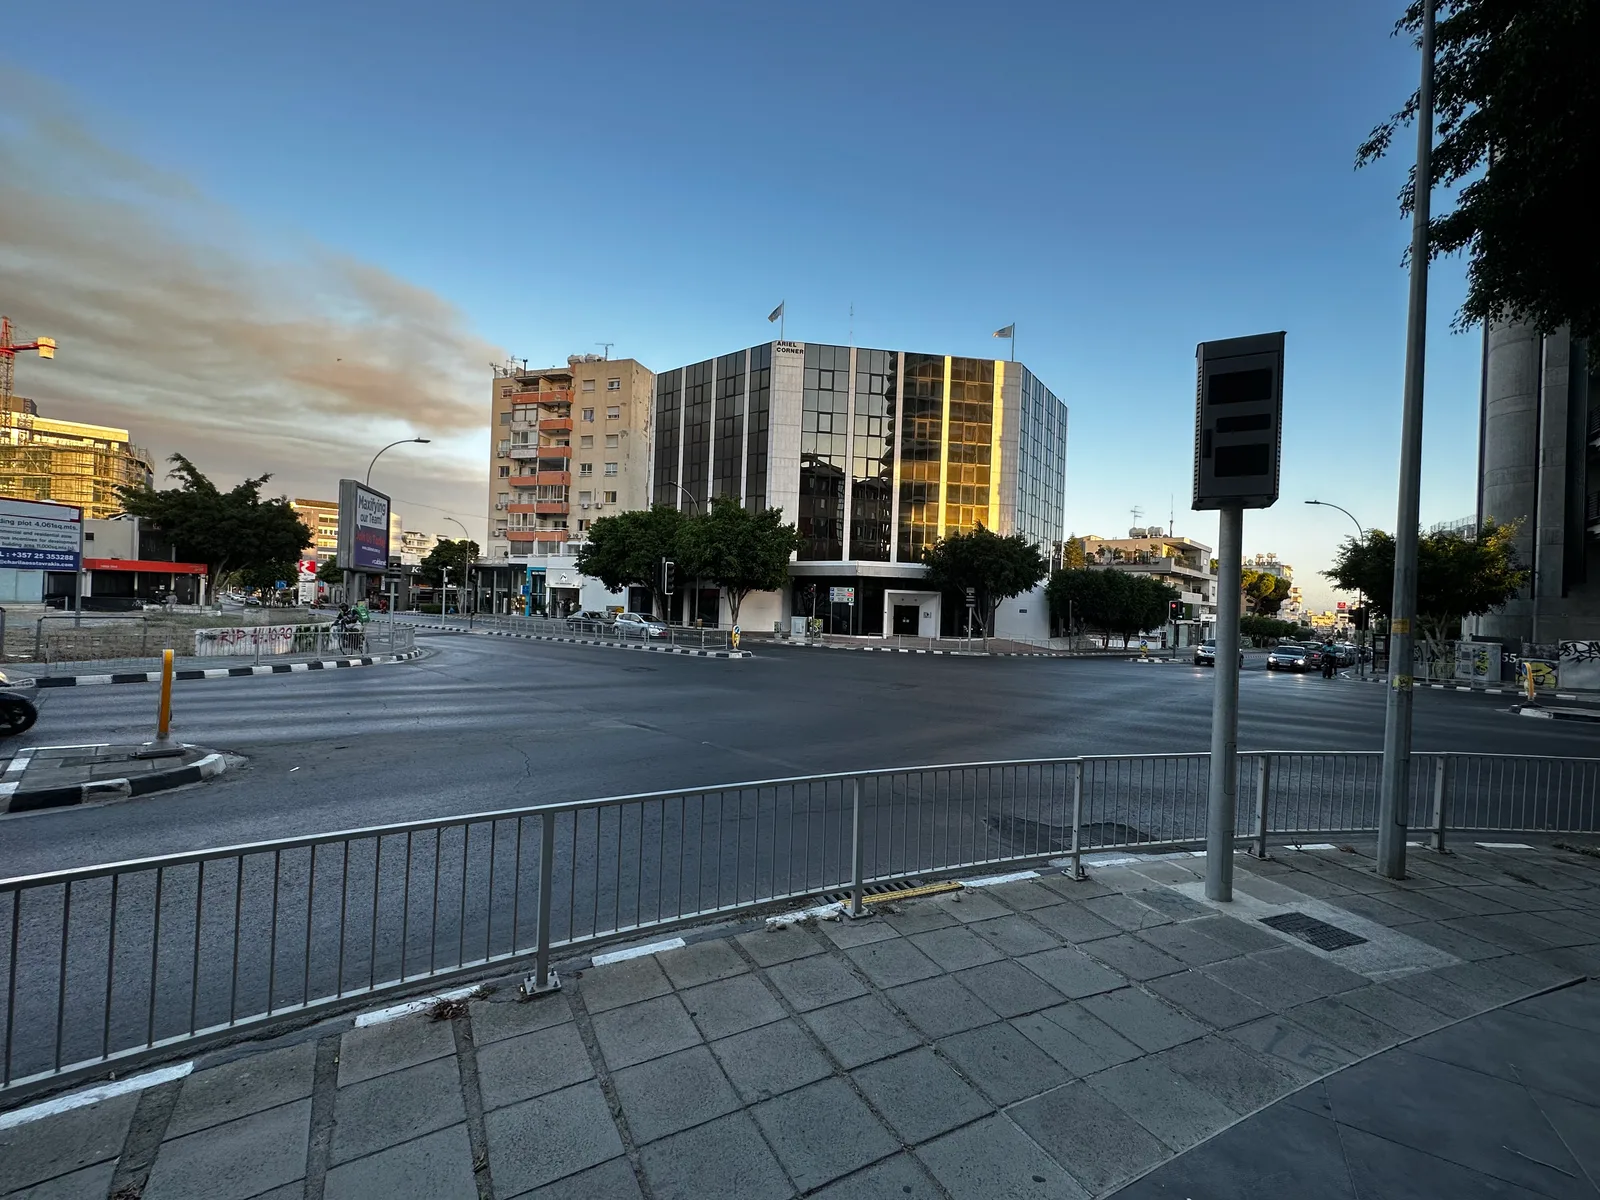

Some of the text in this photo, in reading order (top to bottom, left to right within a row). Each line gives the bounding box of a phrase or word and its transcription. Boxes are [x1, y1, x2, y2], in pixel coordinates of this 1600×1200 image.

[358, 495, 386, 516] Maxifying
[360, 513, 368, 523] our
[1502, 652, 1517, 663] 55
